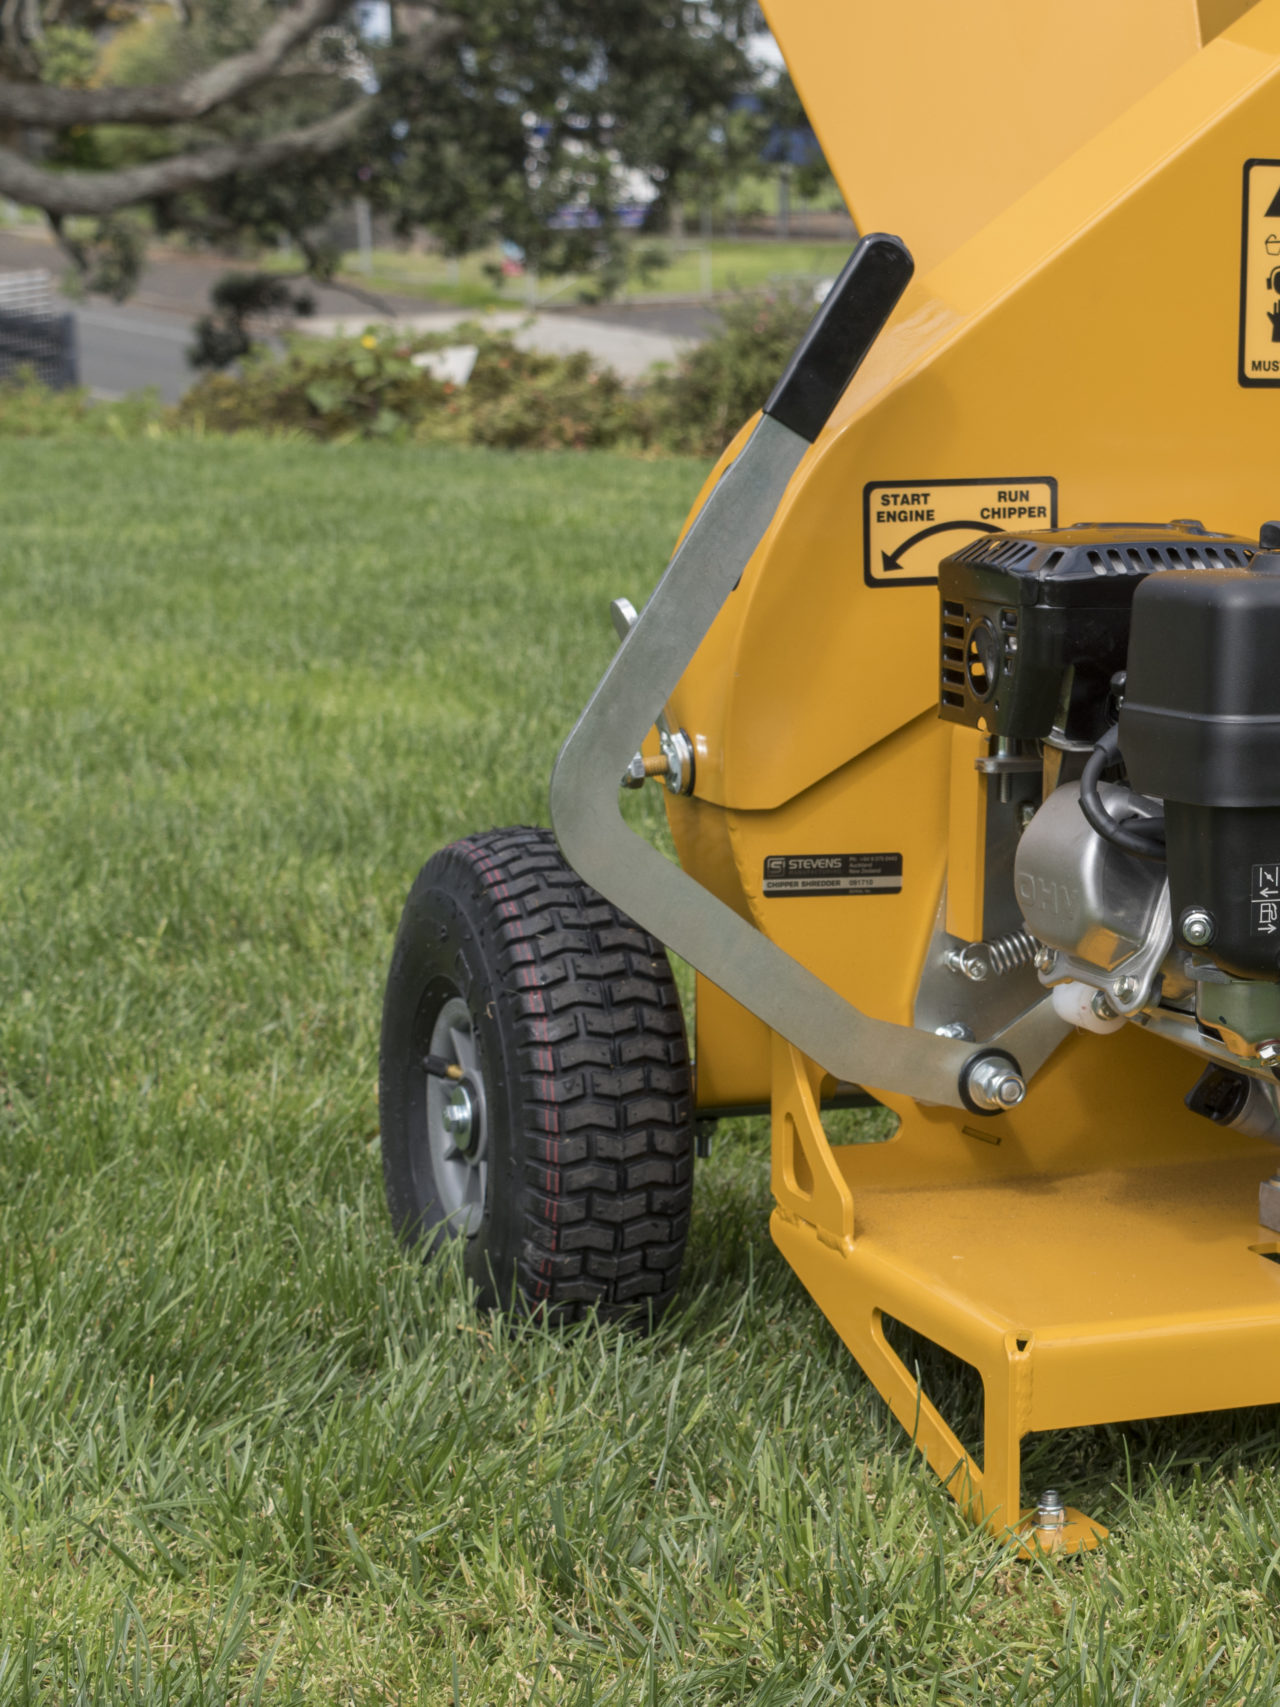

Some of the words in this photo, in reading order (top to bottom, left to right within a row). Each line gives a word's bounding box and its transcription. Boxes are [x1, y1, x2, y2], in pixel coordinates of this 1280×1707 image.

[881, 493, 930, 506] START
[997, 490, 1030, 503] RUN
[876, 509, 935, 523] ENGINE
[980, 506, 1047, 519] CHIPPER
[788, 858, 842, 869] STEVENS
